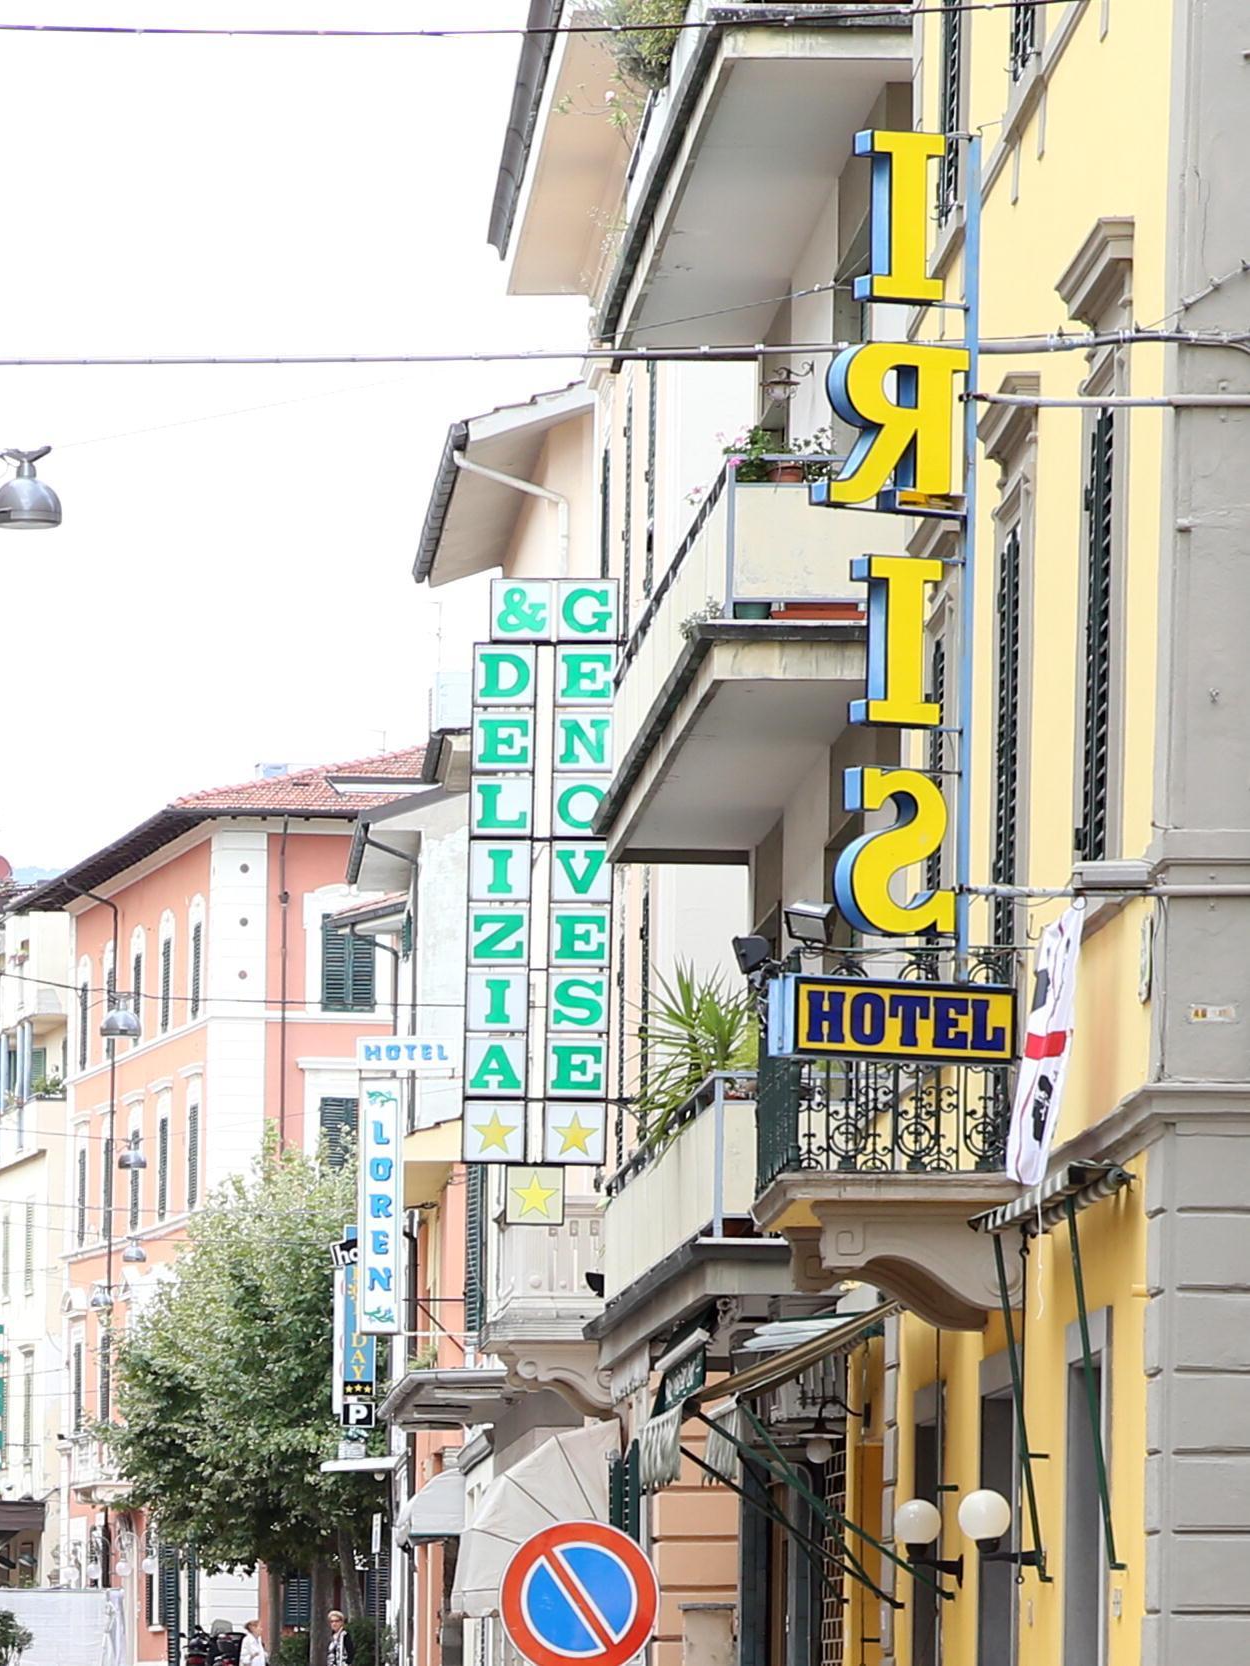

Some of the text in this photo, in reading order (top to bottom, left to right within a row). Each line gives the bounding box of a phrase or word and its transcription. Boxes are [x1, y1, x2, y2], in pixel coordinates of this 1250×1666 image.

[469, 587, 546, 1090] & DELIZIA
[551, 588, 613, 1091] GENOVESE
[364, 1044, 448, 1061] HOTEL
[806, 990, 1006, 1051] HOTEL
[368, 1120, 393, 1292] LOREN
[349, 1404, 368, 1424] P
